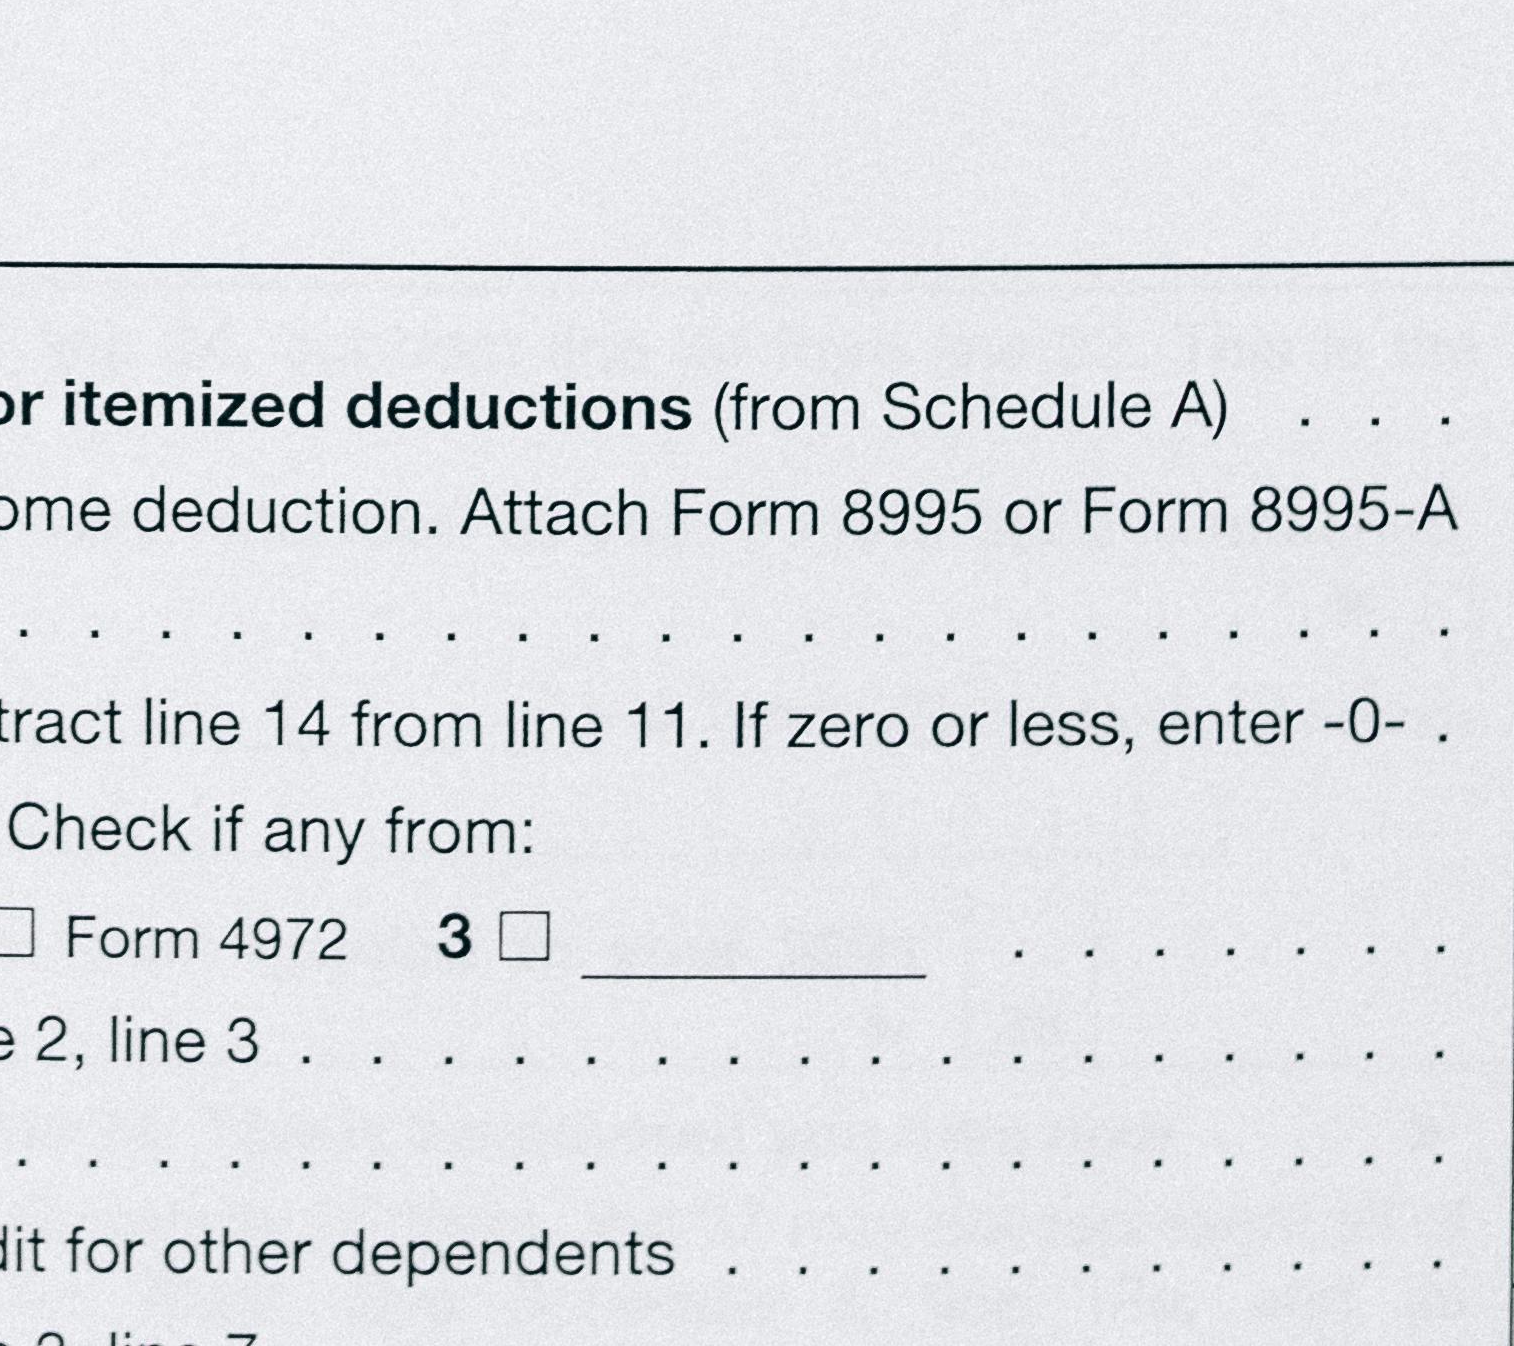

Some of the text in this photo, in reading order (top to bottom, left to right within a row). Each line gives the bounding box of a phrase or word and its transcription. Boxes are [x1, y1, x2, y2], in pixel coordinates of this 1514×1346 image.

[64, 377, 325, 430] itemized
[345, 379, 694, 432] deductions
[713, 380, 860, 445] (from
[882, 379, 1153, 432] Schedule
[1169, 377, 1228, 442] A)
[132, 483, 438, 536] deduction.
[458, 486, 649, 537] Attach
[672, 486, 820, 537] Form
[841, 487, 983, 537] 8995
[1003, 497, 1064, 536] or
[1083, 484, 1228, 535] Form
[1250, 482, 1460, 534] 8995-A
[144, 695, 242, 747] line
[264, 698, 331, 748] 14
[349, 697, 483, 749] from
[506, 698, 604, 749] line
[626, 700, 710, 750] 11.
[735, 699, 770, 750] If
[786, 711, 910, 750] zero
[930, 710, 990, 749] or
[1009, 698, 1135, 756] less,
[1158, 699, 1306, 747] enter
[1323, 695, 1406, 745] -0-
[7, 800, 193, 853] Check
[213, 802, 246, 853] if
[263, 816, 367, 867] any
[384, 804, 533, 855] from:
[67, 913, 199, 960] Form
[218, 915, 348, 962] 4972
[437, 911, 473, 960] 3
[35, 1014, 85, 1072] 2,
[110, 1013, 207, 1064] line
[226, 1015, 260, 1065] 3
[64, 1224, 145, 1275] for
[163, 1226, 314, 1276] other
[331, 1226, 676, 1289] dependents
